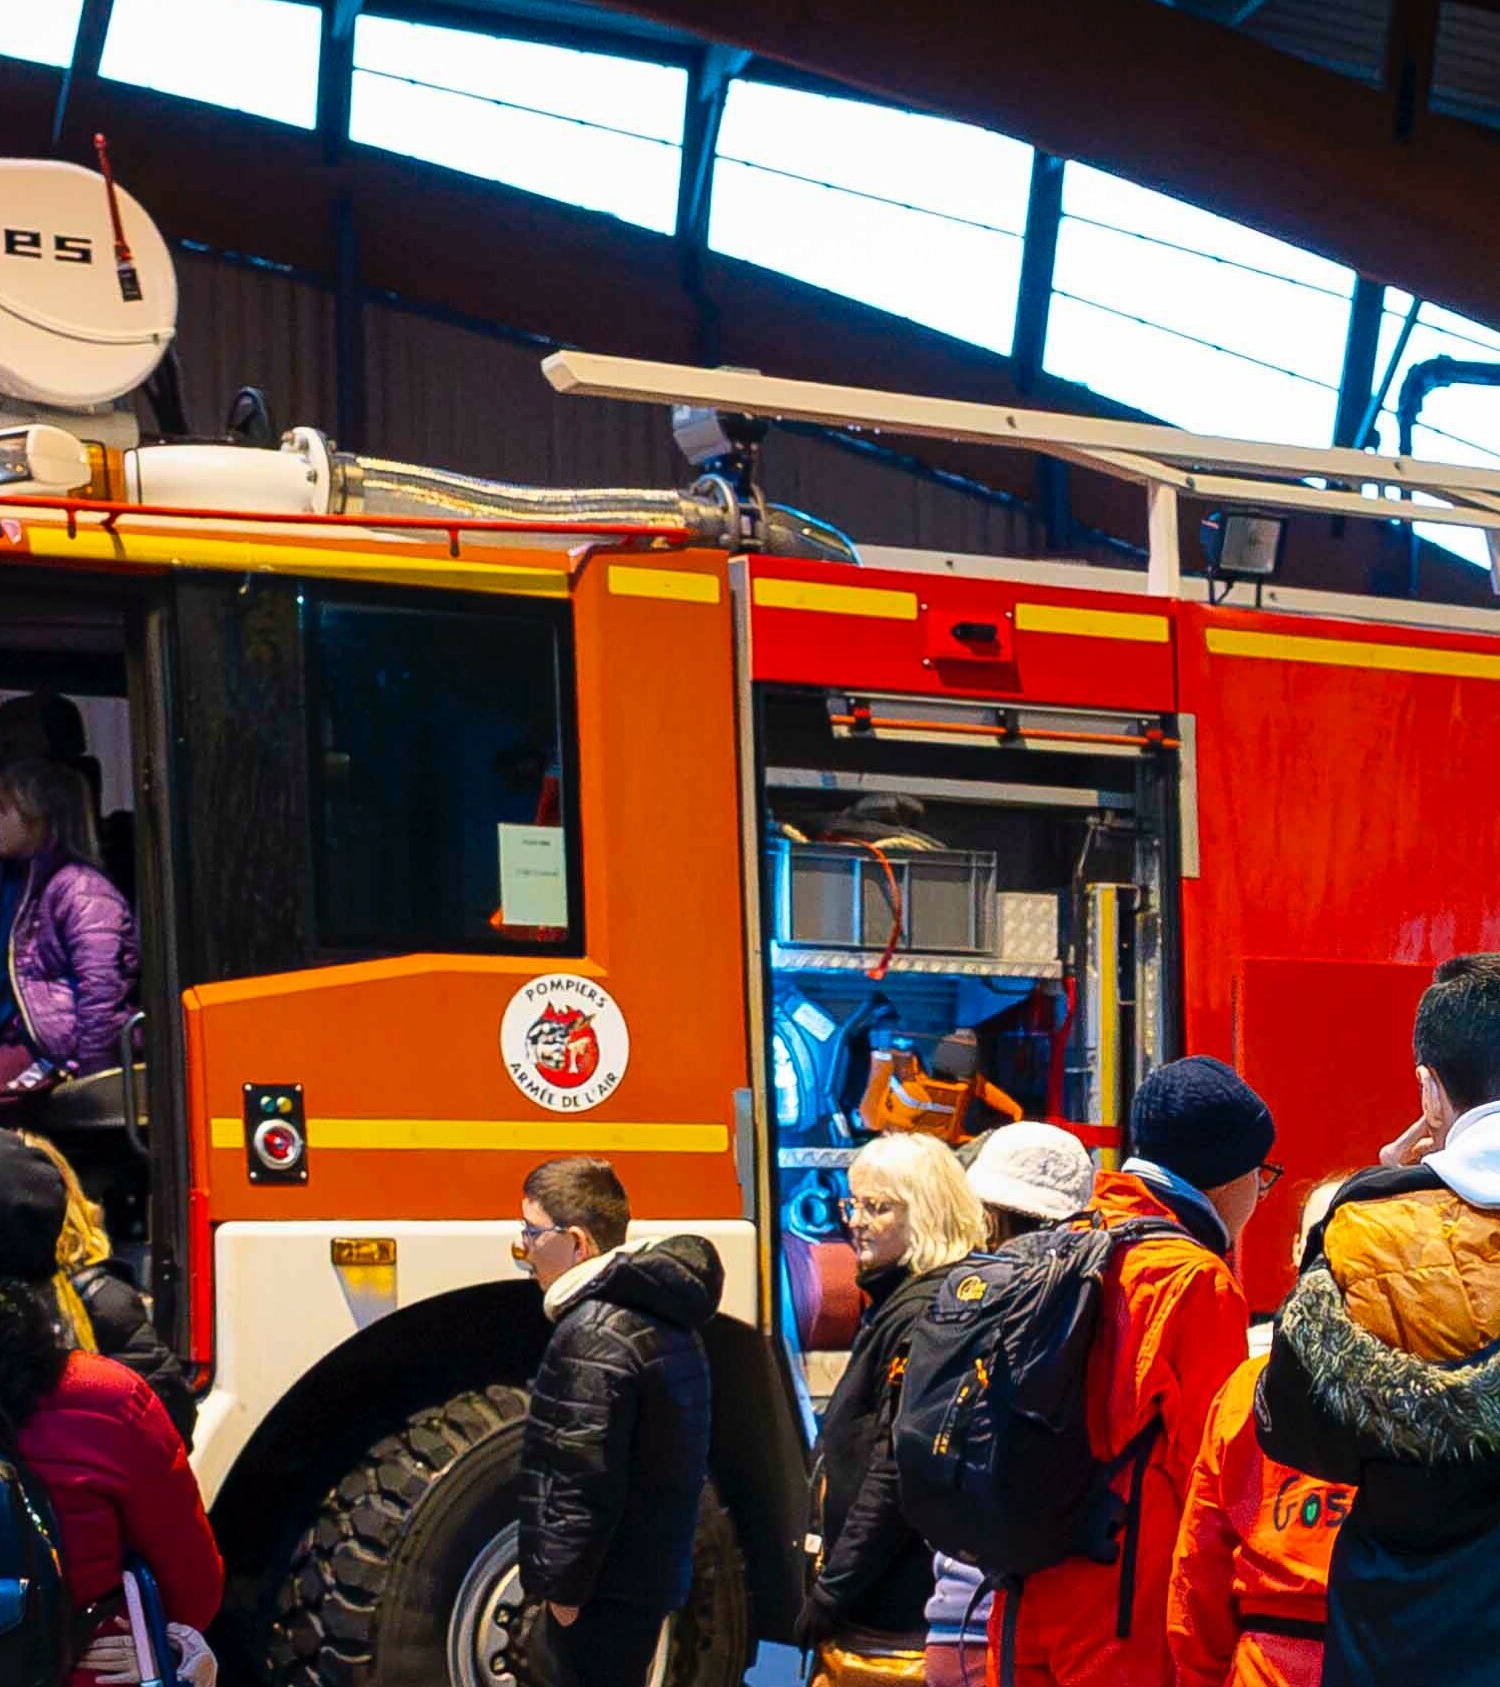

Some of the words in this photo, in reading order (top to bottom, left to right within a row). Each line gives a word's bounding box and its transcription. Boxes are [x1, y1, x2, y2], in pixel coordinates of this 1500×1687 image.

[525, 979, 607, 1008] POMPIERS
[562, 1096, 581, 1108] DE
[585, 1072, 618, 1103] L'AIR
[1273, 1475, 1348, 1532] Gos
